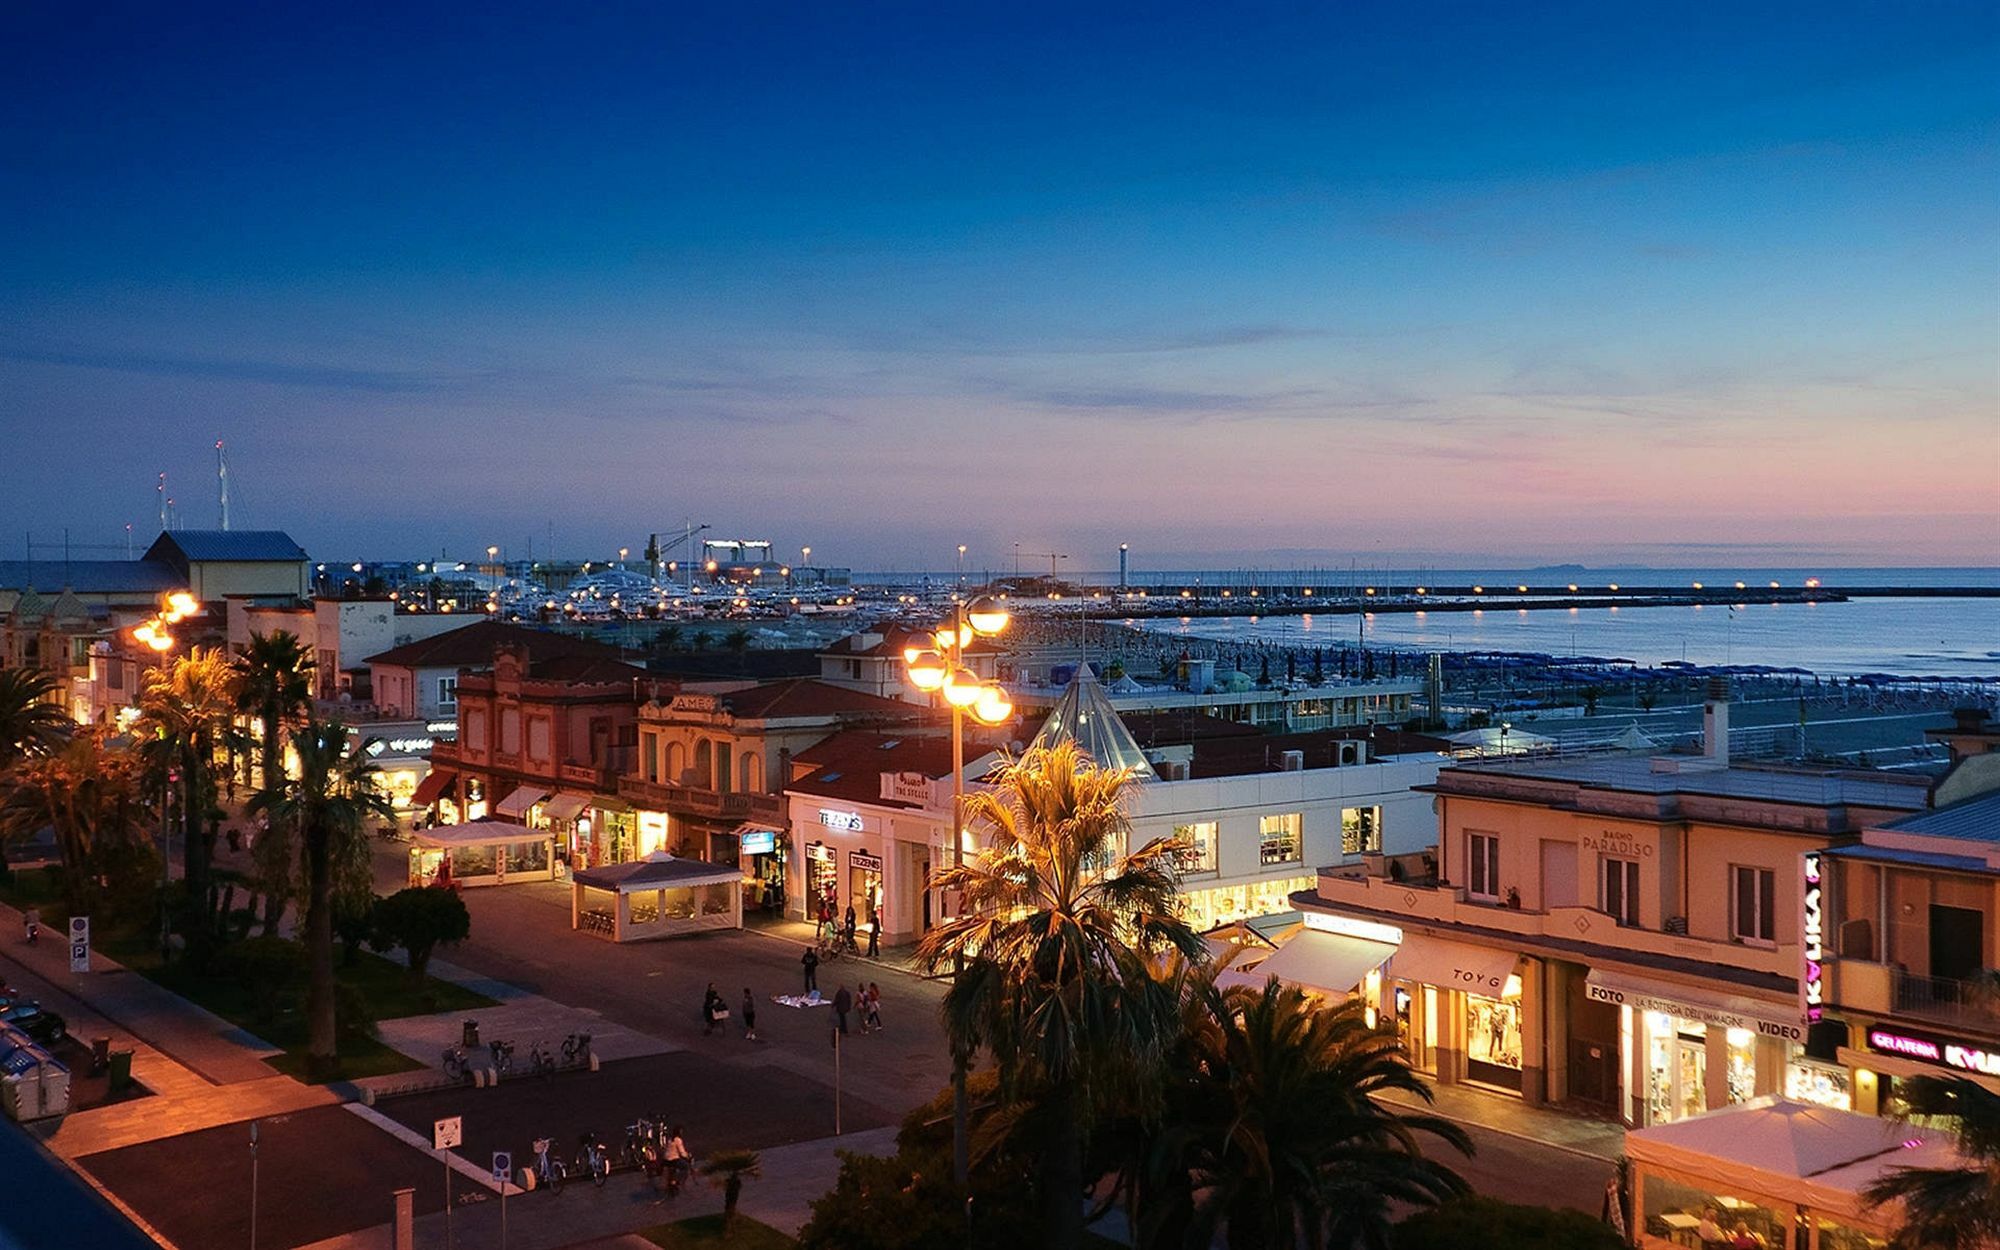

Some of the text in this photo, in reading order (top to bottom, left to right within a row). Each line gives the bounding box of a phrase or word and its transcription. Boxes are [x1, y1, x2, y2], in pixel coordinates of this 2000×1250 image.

[1583, 836, 1653, 857] PARADISO
[852, 855, 880, 870] TEZENIS
[1453, 968, 1500, 987] TOY G
[1591, 986, 1624, 1004] FOTO
[1647, 1000, 1683, 1016] BOTTEGA
[1757, 1020, 1801, 1041] VIDEO
[1871, 1032, 1940, 1060] GELATERIA
